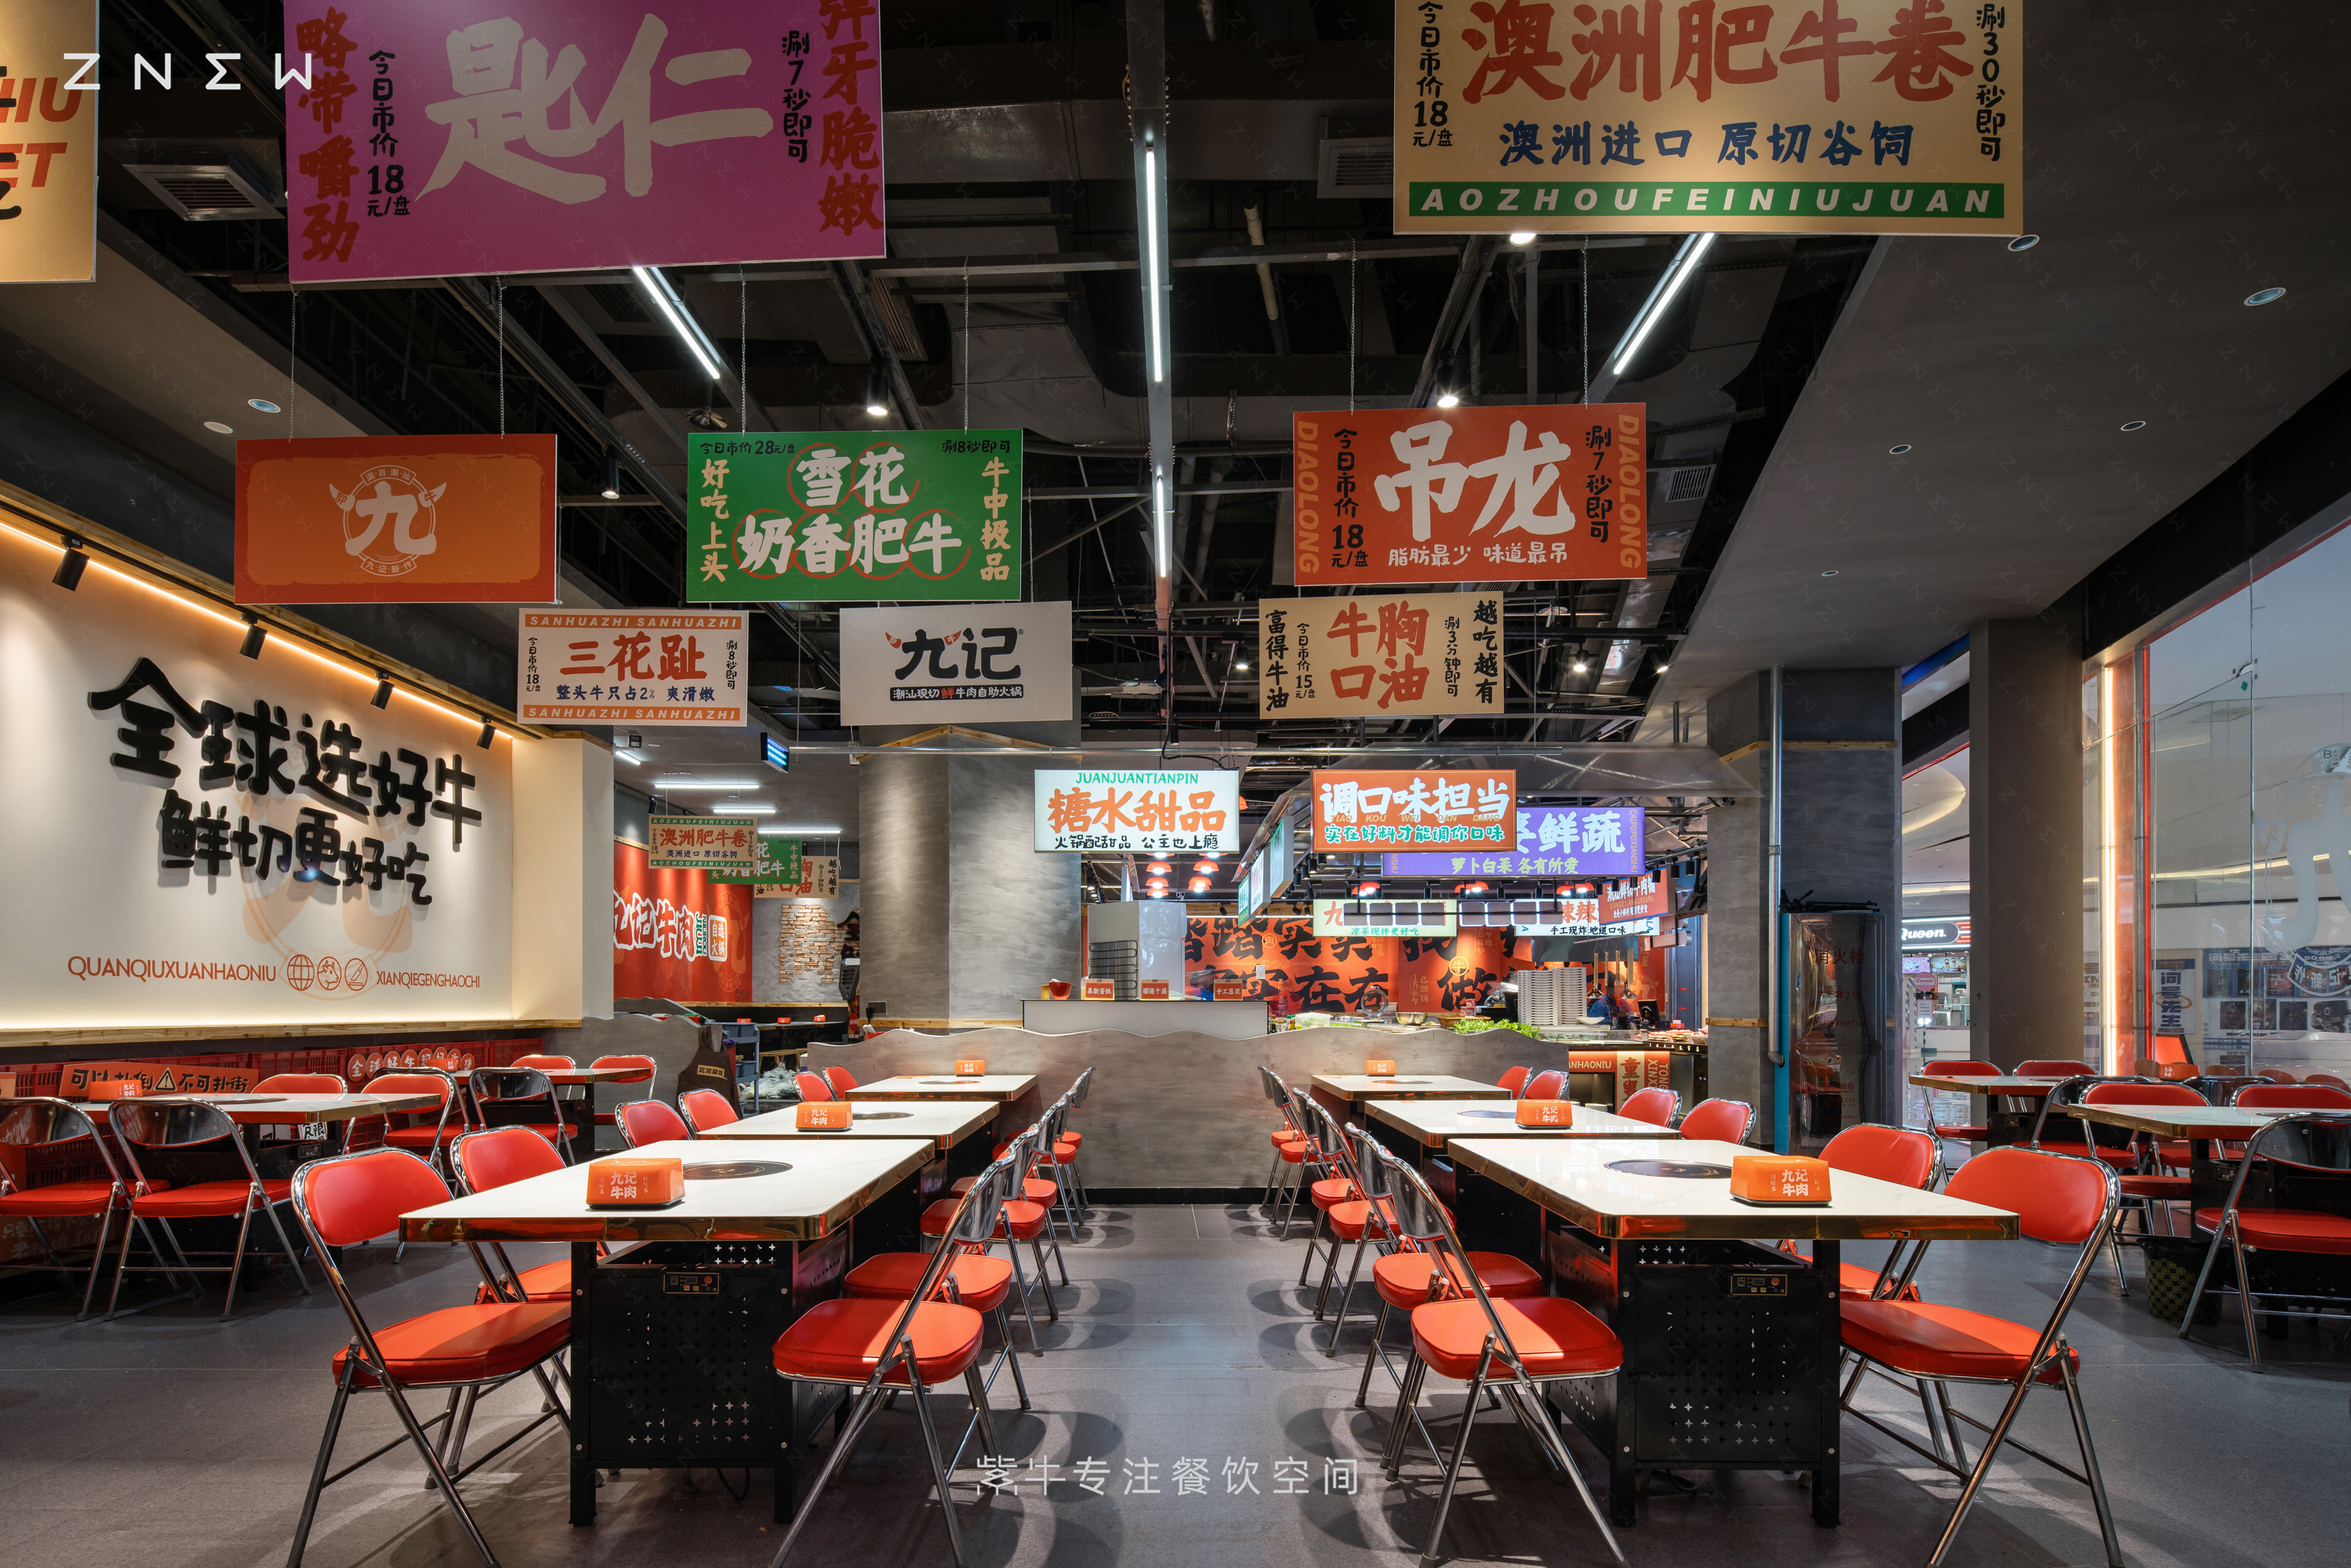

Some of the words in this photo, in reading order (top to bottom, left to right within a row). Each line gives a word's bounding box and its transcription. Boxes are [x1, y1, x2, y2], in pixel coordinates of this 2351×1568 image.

[1461, 0, 1974, 104] 澳洲肥牛卷
[415, 13, 773, 205] 匙仁
[296, 6, 360, 263] 略带嚼劲
[1499, 120, 1645, 166] 澳洲进口
[1717, 120, 1914, 166] 原切谷饲
[1421, 188, 1990, 212] AOZHOUFEINIUJUAN
[796, 446, 910, 507] 雪花
[1298, 420, 1320, 574] DIAOLONG
[1374, 419, 1576, 542] 吊龙
[1619, 414, 1642, 569] DIAOLONG
[345, 480, 438, 557] 九
[699, 458, 730, 583] 好吃上头
[979, 456, 1012, 582] 牛中极品
[736, 512, 962, 575] 奶香肥牛
[1388, 544, 1471, 567] 脂肪最少
[1484, 541, 1568, 564] 味道最吊
[529, 616, 630, 627] SANHUAZHI
[637, 617, 737, 628] SANHUAZHI
[559, 630, 708, 682] 三花趾
[894, 627, 1022, 681] 九记
[1264, 608, 1290, 712] 富得牛油
[1473, 599, 1499, 705] 越吃越有
[528, 707, 628, 719] SANHUAZHI
[635, 709, 736, 720] SANHUAZHI
[555, 684, 656, 701] 整头牛只占2%
[667, 686, 715, 702] 爽滑嫩
[892, 686, 1023, 700] 潮汕现切鲜牛肉自助火锅
[88, 657, 482, 846] 全球选好牛
[1075, 772, 1199, 785] JUANJUANTIANPIN
[1047, 786, 1227, 834] 糖水甜品
[1319, 777, 1510, 824] 调口味担当
[1472, 814, 1501, 822] DANG
[160, 788, 433, 906] 鲜切更好吃
[660, 827, 748, 848] 澳洲肥牛卷
[666, 849, 700, 858] 澳洲进口
[703, 850, 738, 858] 原切谷饲
[1142, 833, 1219, 850] 公主也上瘾
[1324, 823, 1506, 844] 实在好料才能调你口味
[828, 858, 838, 896] 越吃越有
[1451, 857, 1513, 875] 萝卜白菜
[1518, 857, 1579, 875] 各有所爱
[67, 956, 277, 982] QUANQIUXUANHAONIU
[376, 970, 481, 989] XIANQIEGENGHAOCHI
[178, 1073, 249, 1093] 不可扑街
[610, 1185, 638, 1200] 牛肉
[611, 1171, 638, 1185] 九记
[1781, 1168, 1809, 1183] 九记
[1782, 1182, 1809, 1197] 牛肉
